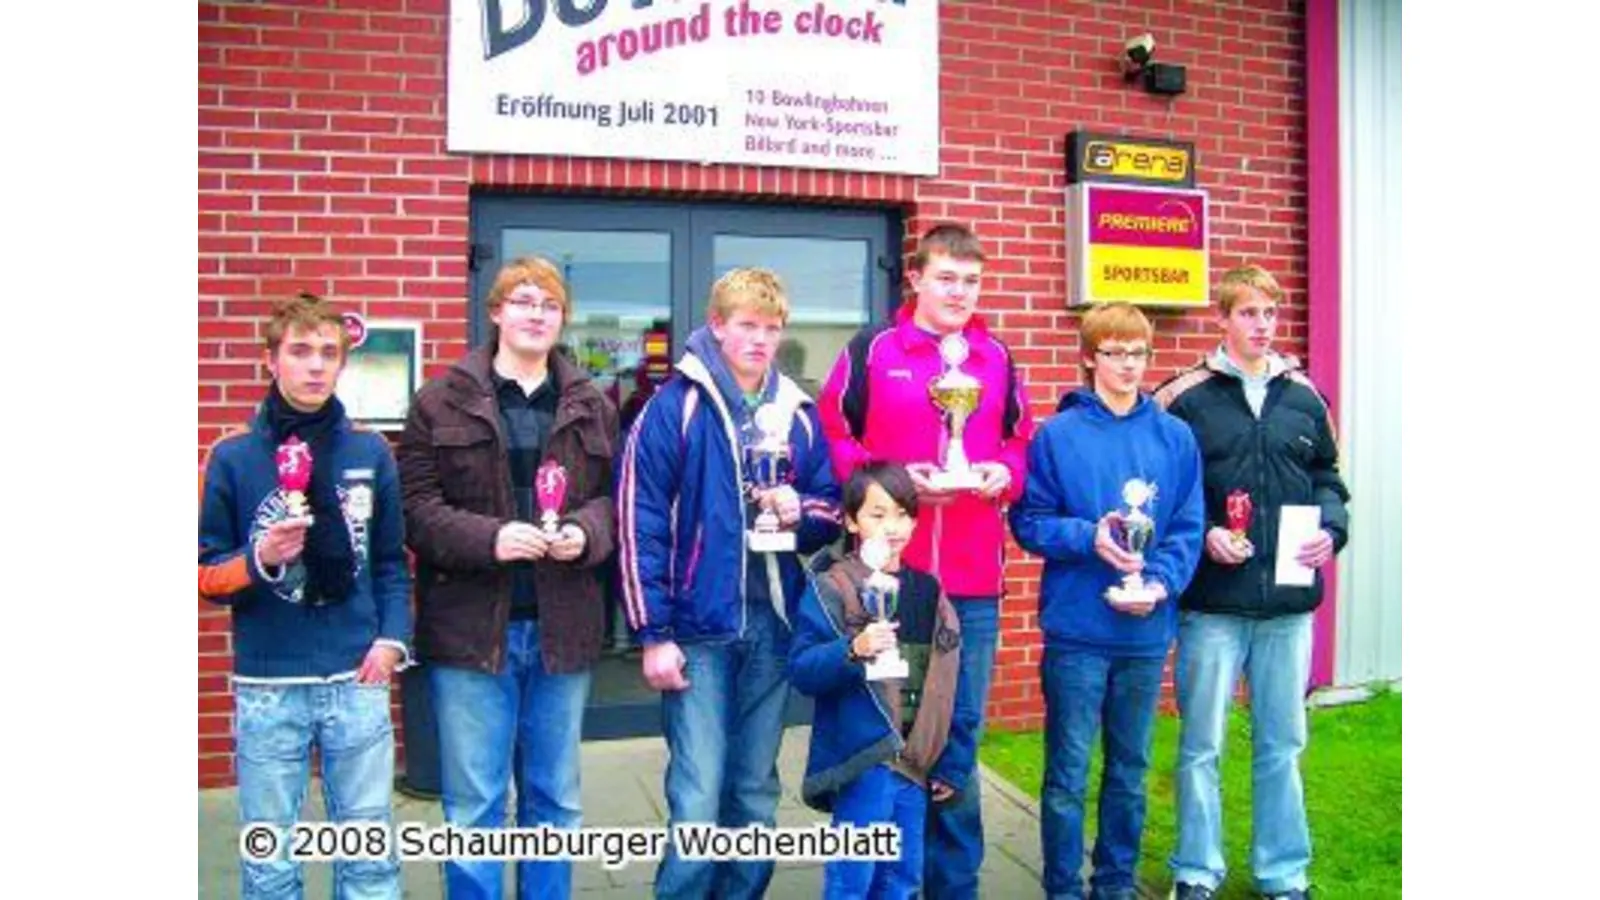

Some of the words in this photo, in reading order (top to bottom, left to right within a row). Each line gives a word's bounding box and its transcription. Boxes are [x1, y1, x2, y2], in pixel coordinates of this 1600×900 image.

[576, 2, 710, 75] around
[724, 0, 782, 37] the
[794, 3, 884, 44] clock
[496, 93, 612, 127] Eröffnung
[616, 100, 654, 127] Juli
[663, 102, 719, 126] 2001
[745, 110, 779, 128] New
[801, 139, 831, 157] and
[835, 143, 875, 159] more
[1092, 146, 1184, 173] arena
[1097, 213, 1192, 235] PREMIERE
[1103, 264, 1190, 284] SPORTSBAR
